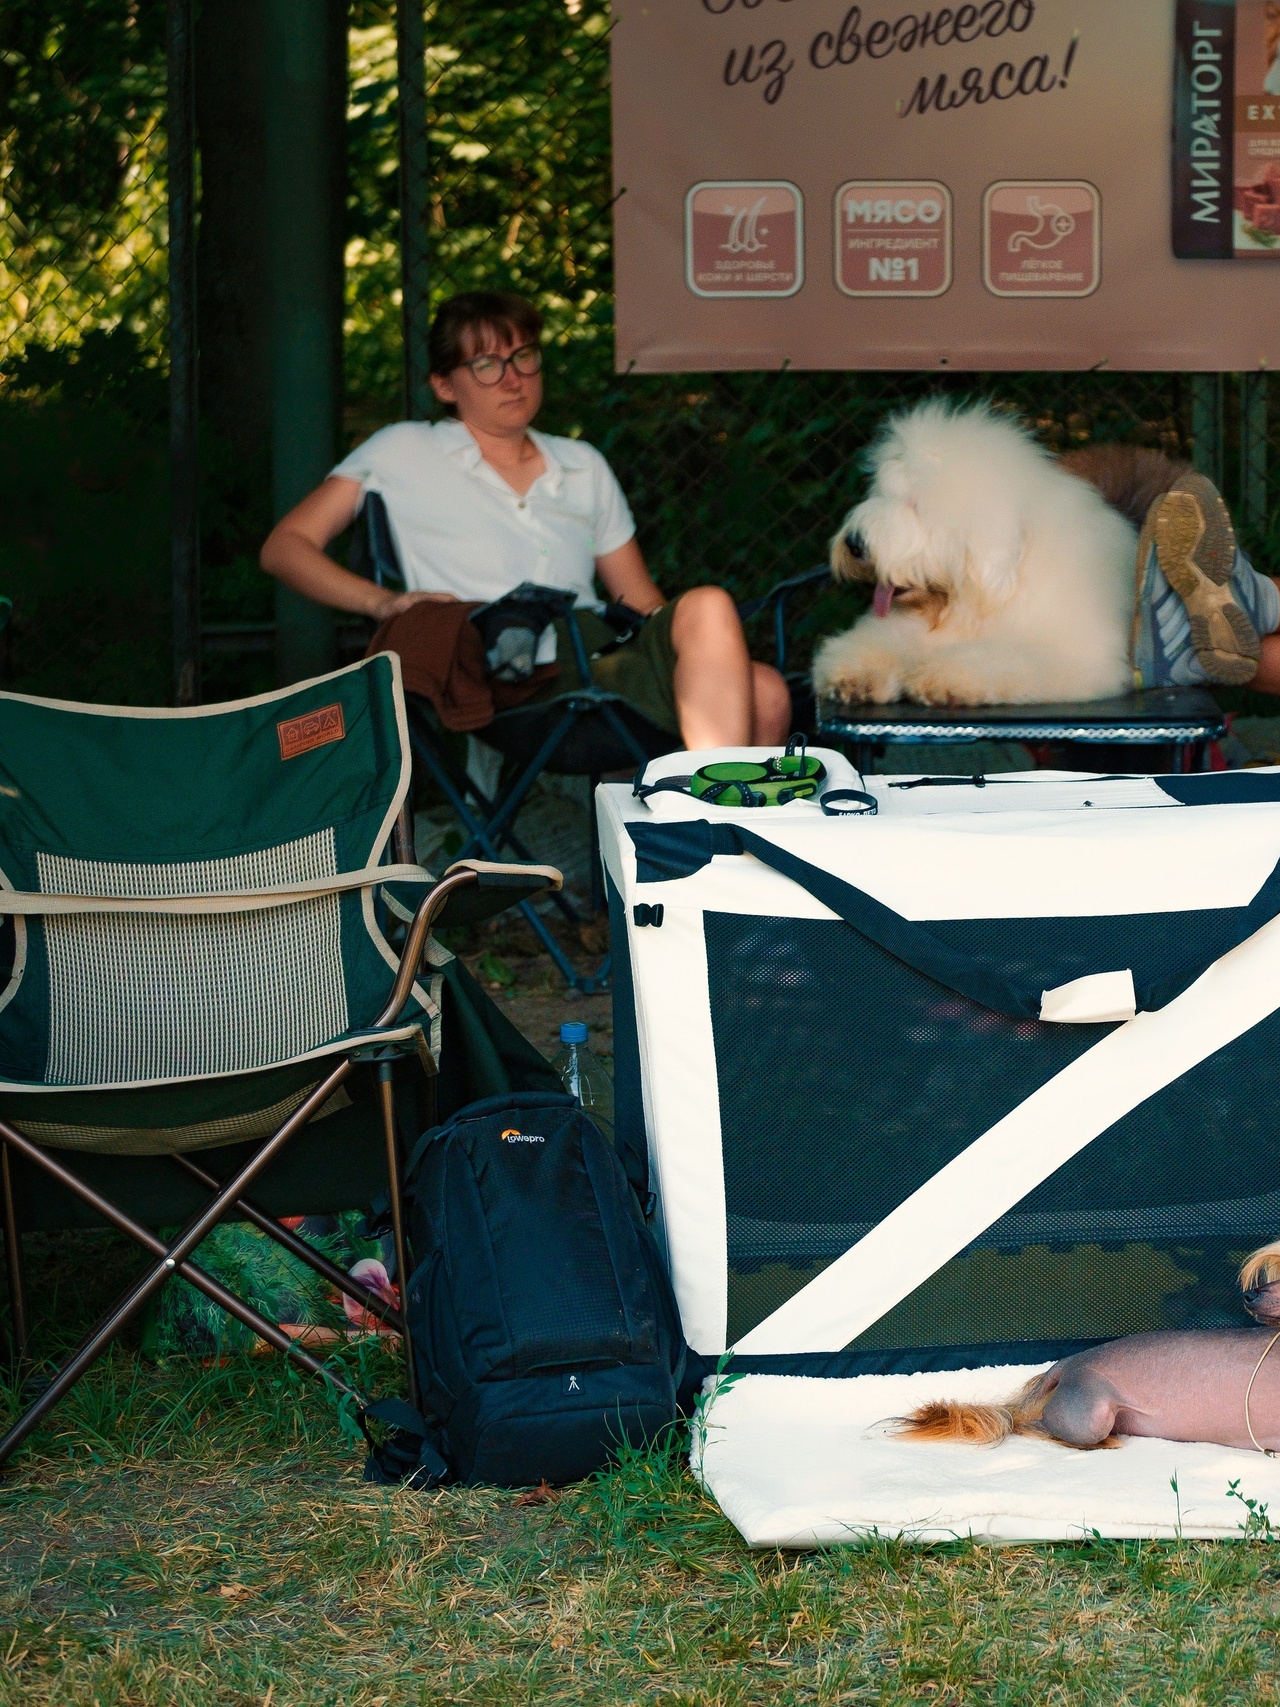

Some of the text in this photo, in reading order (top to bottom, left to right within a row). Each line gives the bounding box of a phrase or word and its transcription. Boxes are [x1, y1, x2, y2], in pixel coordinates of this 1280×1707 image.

[723, 0, 1034, 105] из свежего
[898, 29, 1079, 119] мяса!
[1190, 20, 1223, 224] МИРАТОРГ
[846, 200, 942, 223] МЯСО
[848, 238, 940, 251] ИНГРЕДИЕНТ
[869, 257, 920, 282] №1
